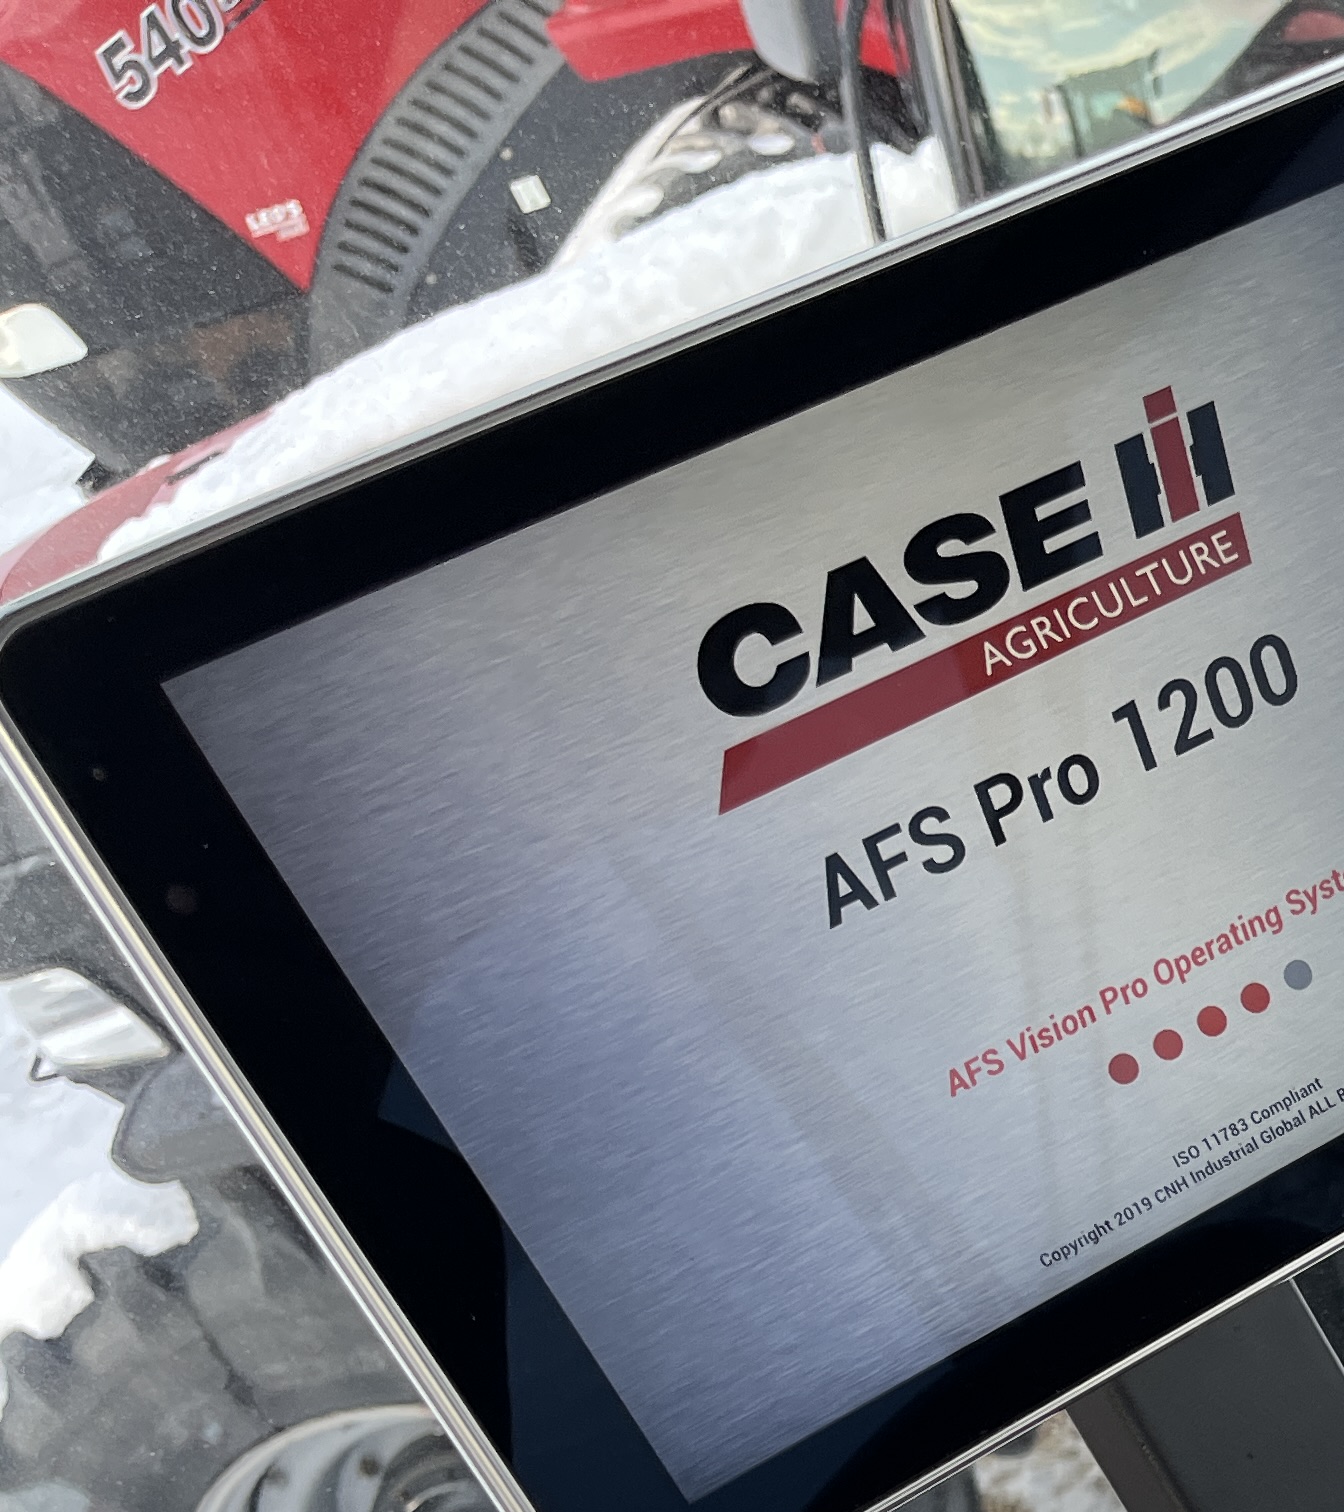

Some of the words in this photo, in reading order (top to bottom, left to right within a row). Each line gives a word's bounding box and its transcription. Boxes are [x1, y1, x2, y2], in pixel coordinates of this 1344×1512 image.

[697, 460, 1104, 717] CASE
[984, 529, 1238, 676] AGRICULTURE
[827, 806, 966, 929] AFS
[974, 753, 1100, 846] Pro
[1113, 633, 1299, 772] 1200
[948, 1050, 1005, 1096] AFS
[1007, 1002, 1096, 1064] Vision
[1100, 978, 1149, 1017] Pro
[1153, 904, 1284, 985] Operating
[1039, 1217, 1114, 1268] Copyright
[1114, 1197, 1153, 1229] 2019
[1155, 1175, 1190, 1204] CNH
[1190, 1137, 1259, 1184] Industrial
[1259, 1111, 1306, 1146] Global
[1308, 1093, 1336, 1119] ALL
[1173, 1143, 1200, 1168] ISO
[1203, 1119, 1248, 1153] 11783
[1250, 1078, 1323, 1128] Compliant
